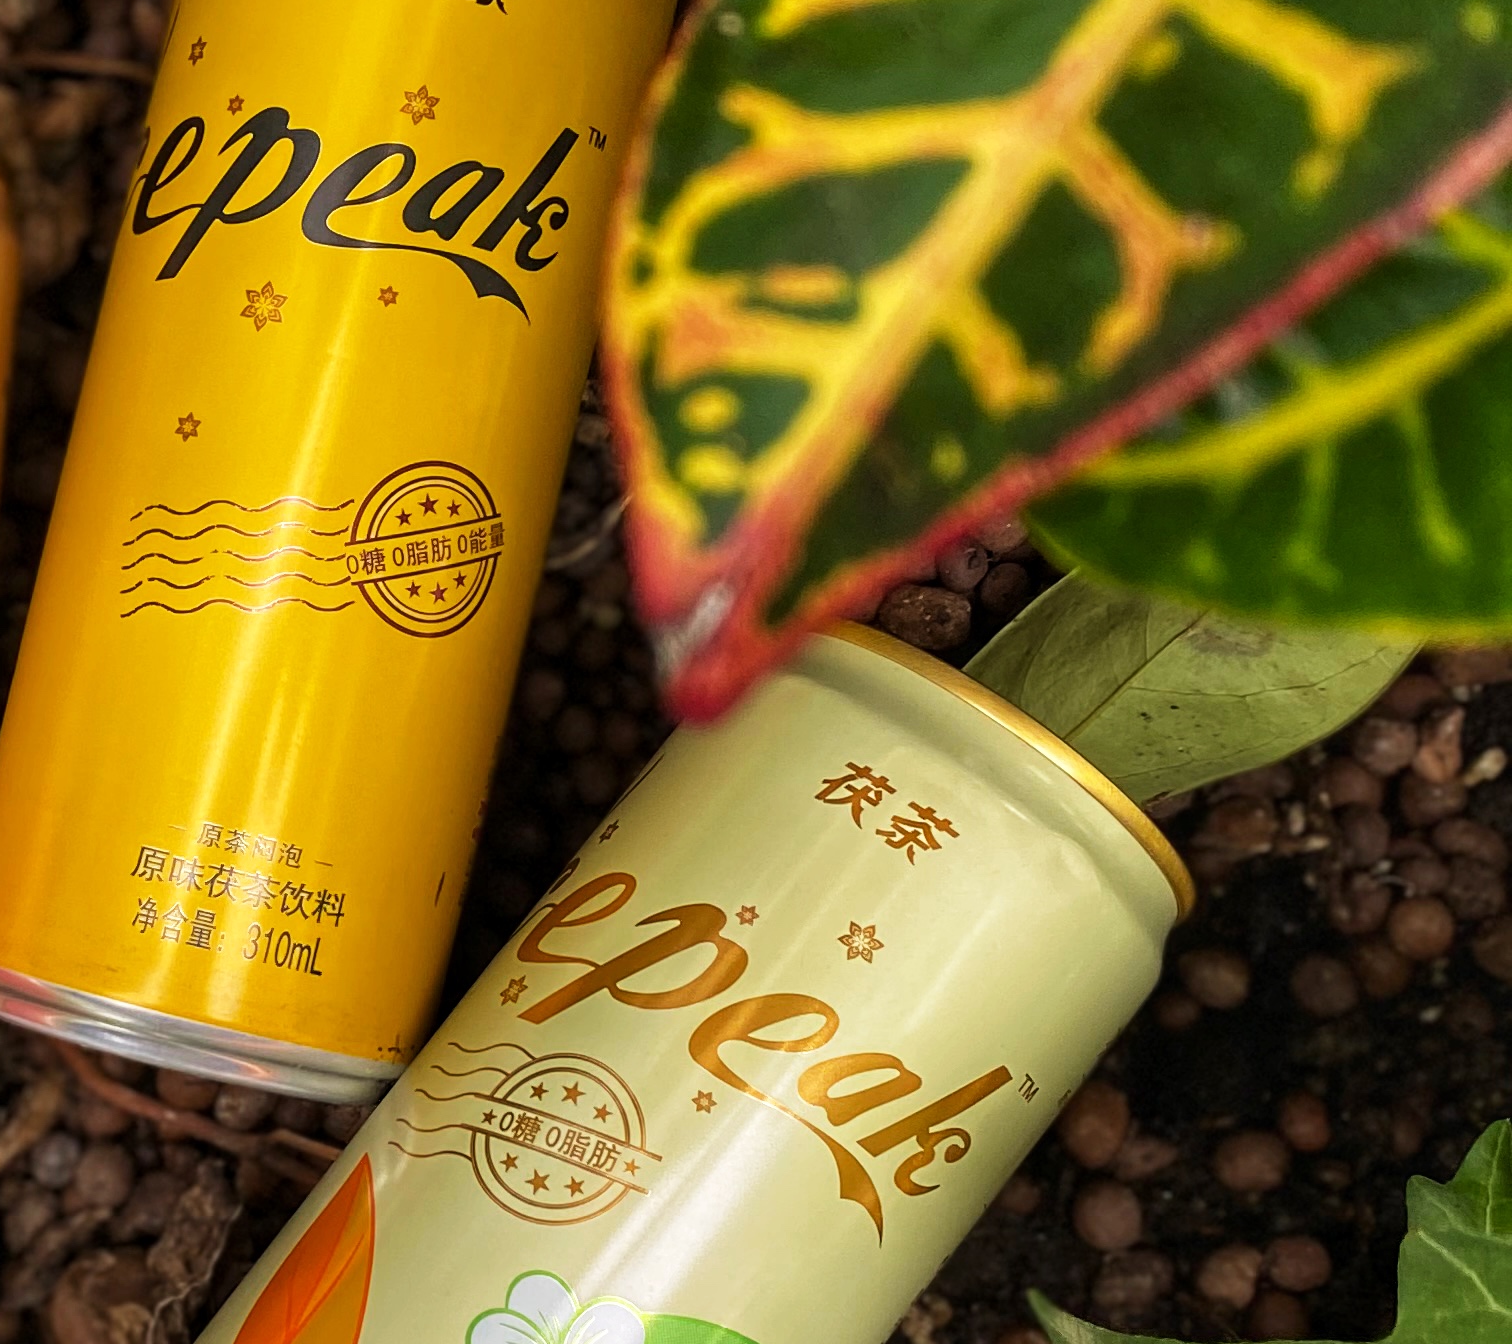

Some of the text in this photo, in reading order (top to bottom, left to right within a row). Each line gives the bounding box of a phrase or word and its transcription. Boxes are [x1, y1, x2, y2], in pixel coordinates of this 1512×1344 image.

[128, 106, 579, 327] epeak
[346, 521, 506, 576] 0糖 0脂肪 0能量
[813, 761, 960, 866] 茯茶
[130, 846, 347, 928] 原味茯茶饮料
[512, 857, 1014, 1248] epeak
[499, 1111, 622, 1173] 0糖 0脂肪
